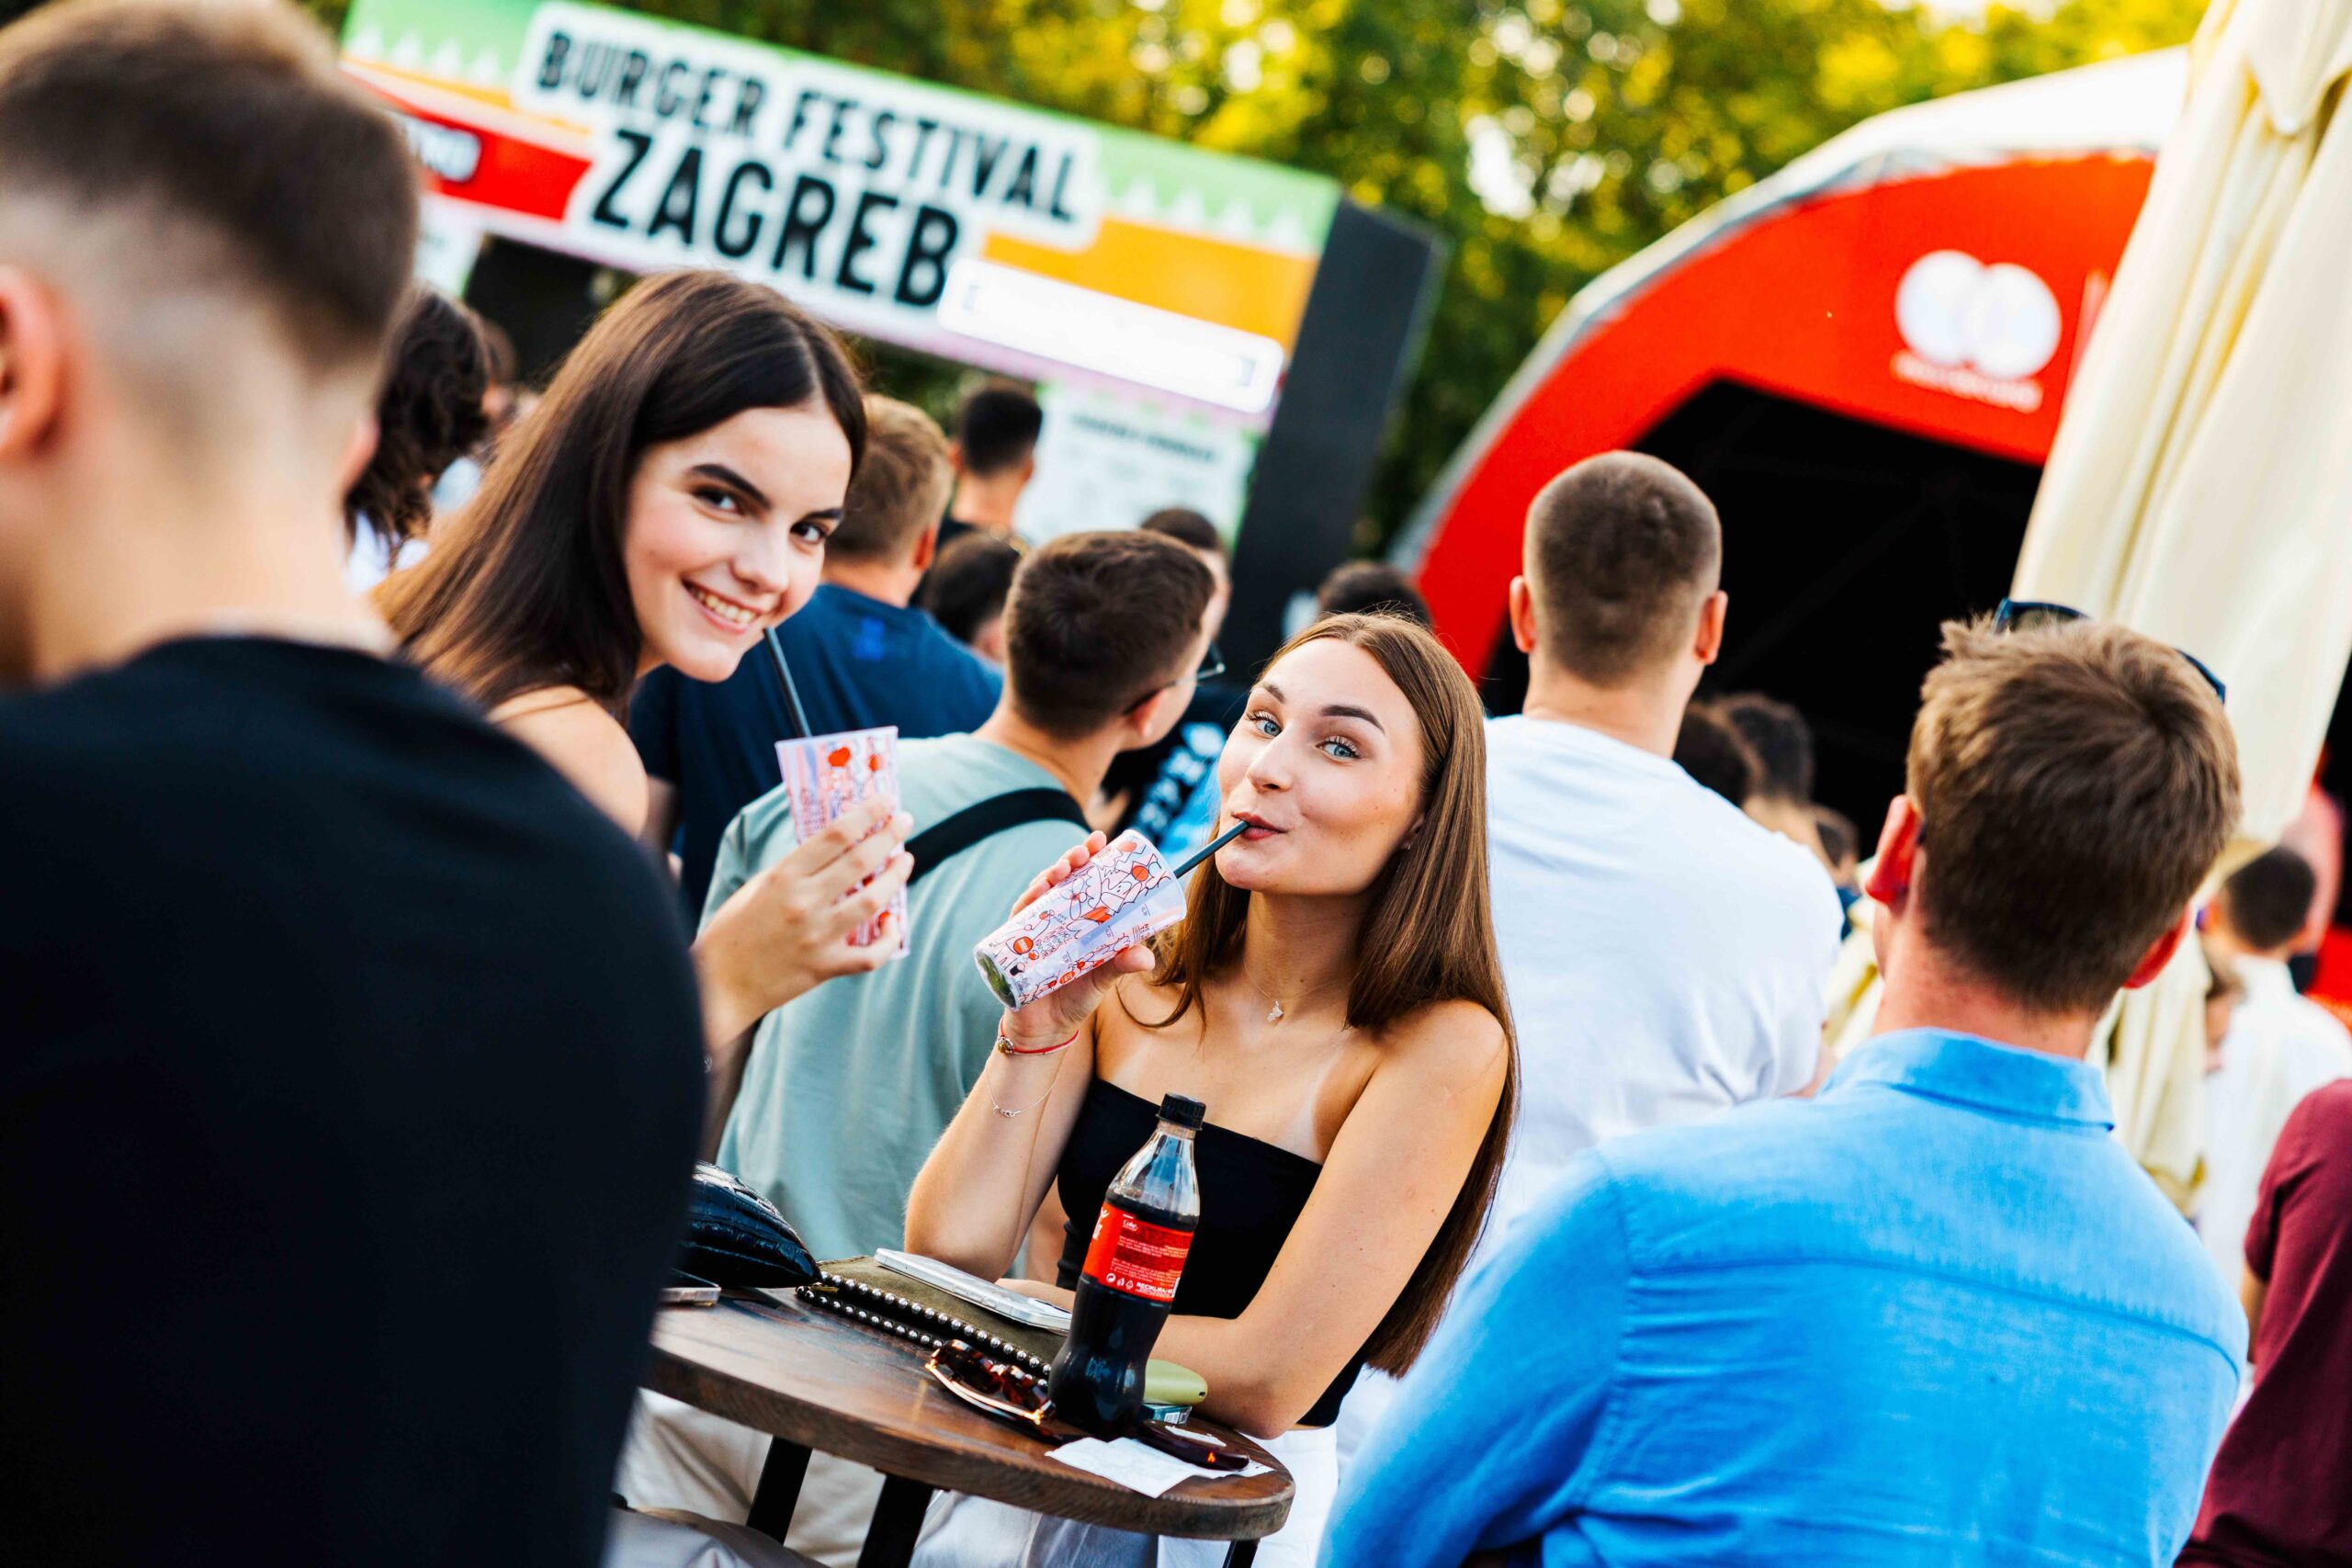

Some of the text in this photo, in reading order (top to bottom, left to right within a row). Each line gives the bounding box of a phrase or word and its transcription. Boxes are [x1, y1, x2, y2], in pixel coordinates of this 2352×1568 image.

[537, 30, 1075, 221] BURGER FESTIVAL
[593, 128, 959, 308] ZAGREB
